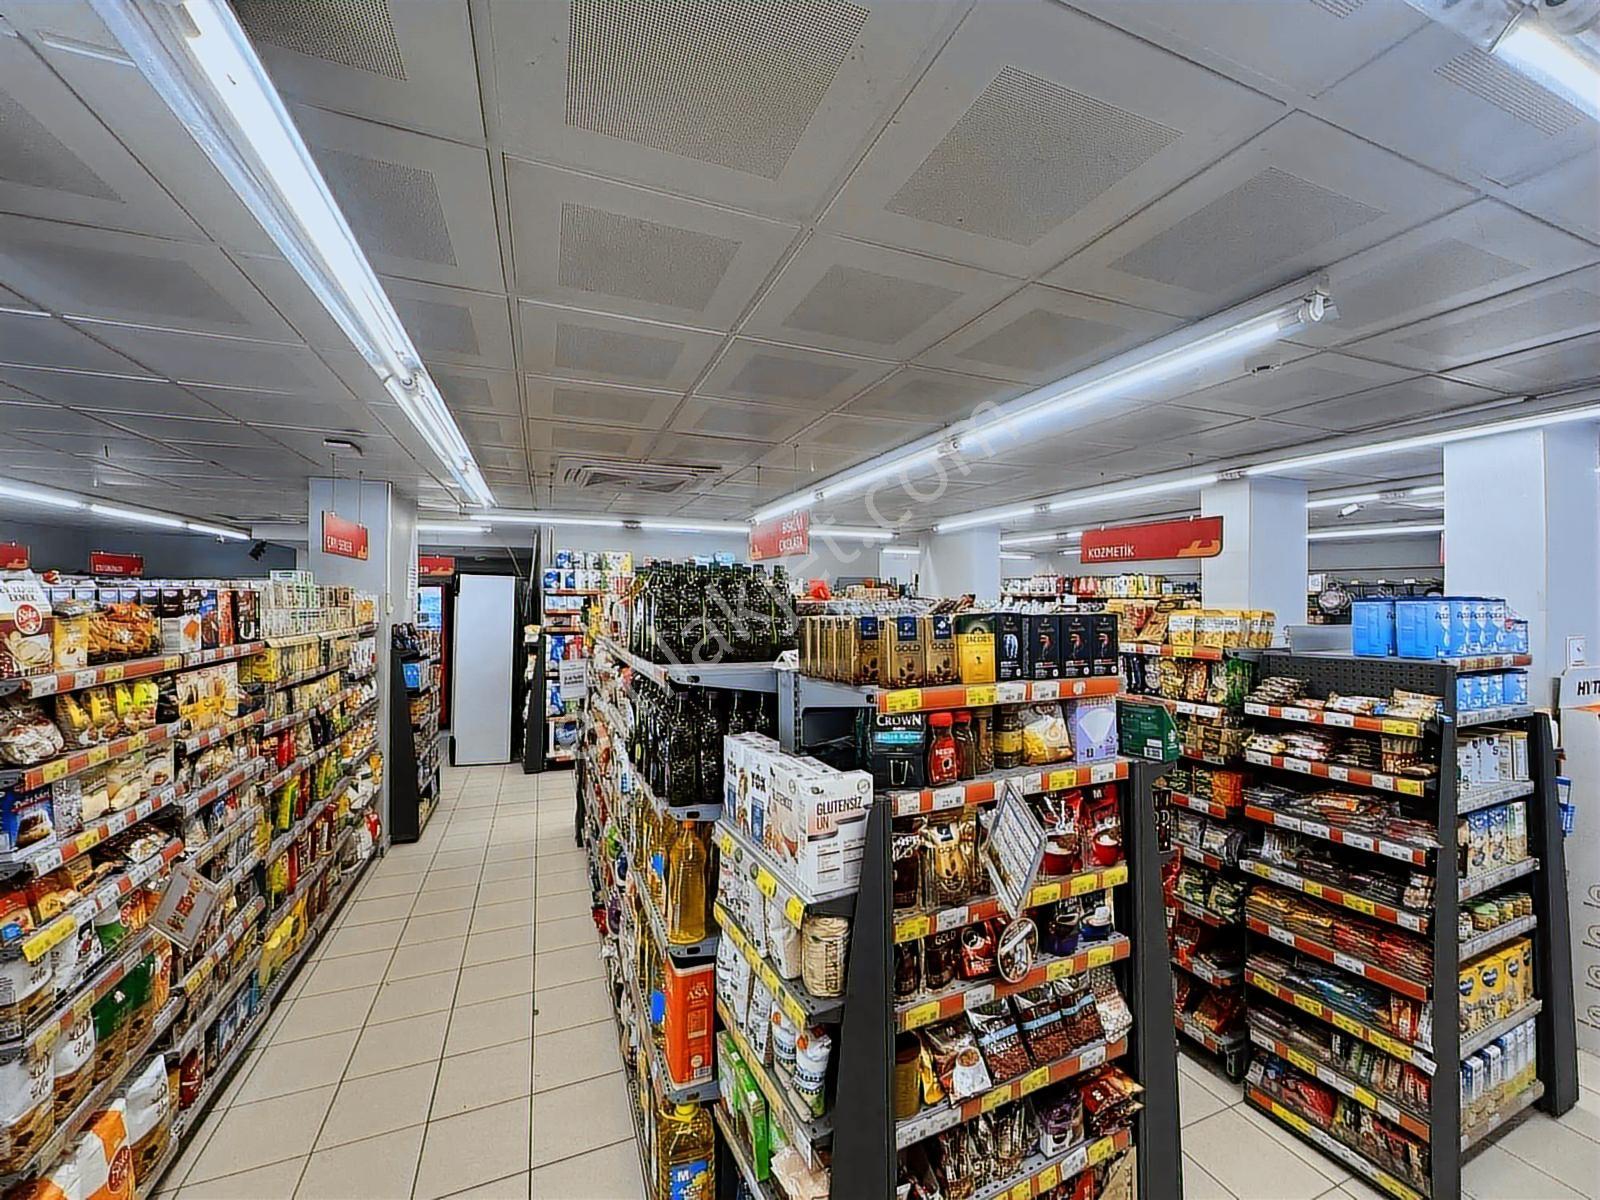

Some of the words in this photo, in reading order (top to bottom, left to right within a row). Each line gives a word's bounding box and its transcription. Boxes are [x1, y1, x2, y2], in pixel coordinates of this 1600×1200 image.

[1088, 542, 1135, 559] KOZMETİK
[894, 643, 921, 652] GOLD
[931, 641, 955, 650] GOLD
[876, 713, 921, 727] CROWN
[816, 793, 863, 816] GLUTENSİZ
[816, 815, 830, 831] UN
